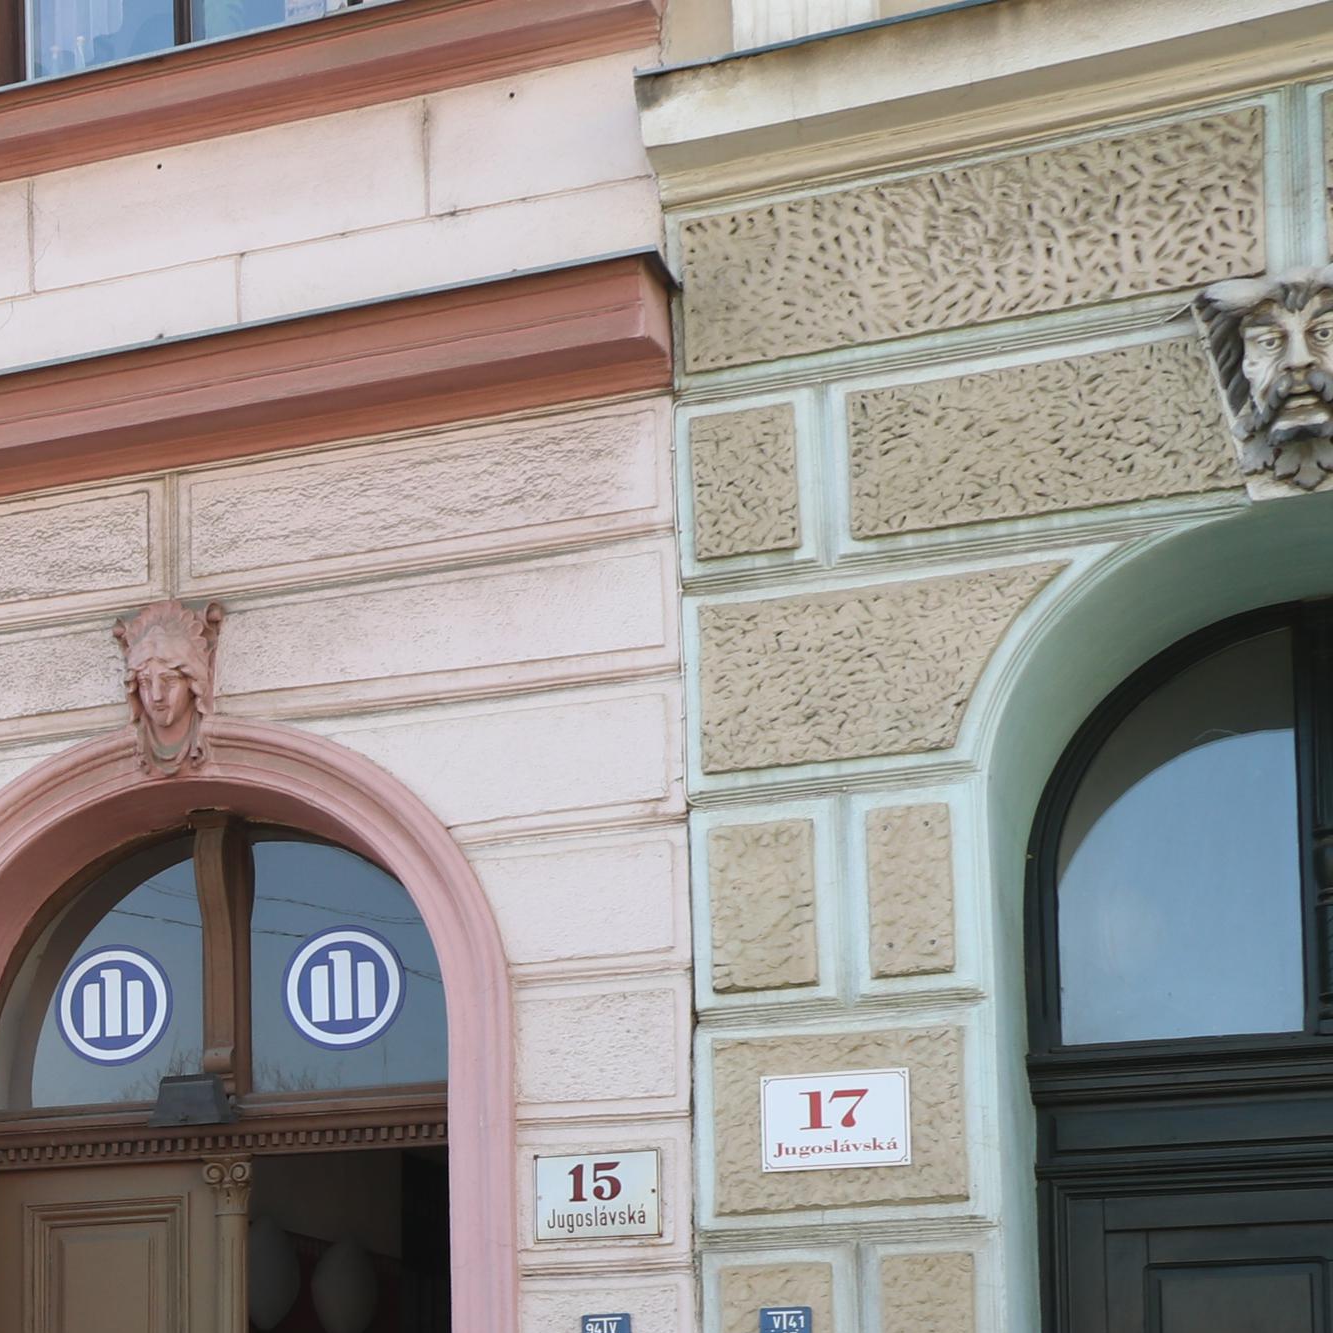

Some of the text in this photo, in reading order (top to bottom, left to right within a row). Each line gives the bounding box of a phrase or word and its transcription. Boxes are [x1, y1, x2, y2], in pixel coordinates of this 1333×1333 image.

[798, 1088, 870, 1131] 17
[773, 1136, 898, 1159] Jugoslávská
[567, 1161, 622, 1203] 15
[547, 1203, 646, 1234] Jugoslávská
